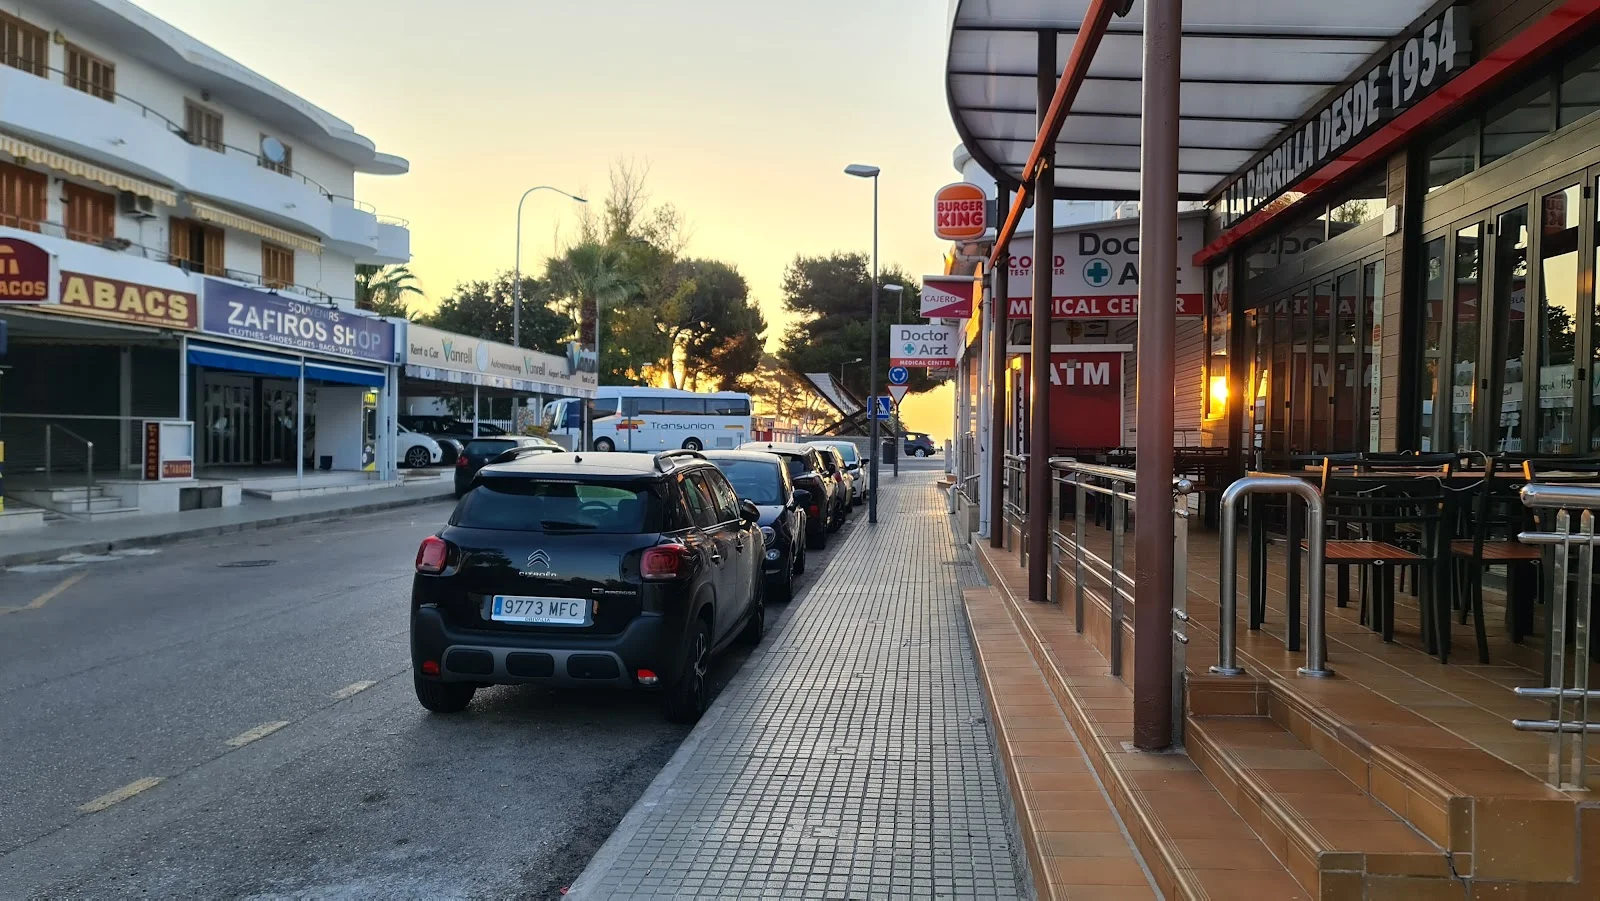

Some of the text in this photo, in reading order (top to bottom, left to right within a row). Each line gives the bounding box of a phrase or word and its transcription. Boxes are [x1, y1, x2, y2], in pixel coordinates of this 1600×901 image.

[1220, 5, 1457, 230] A LA PARRILLA DESDE 1954
[937, 201, 983, 212] BURGER
[937, 211, 983, 227] KING
[1008, 255, 1065, 268] COD
[61, 276, 189, 321] ABACS
[924, 295, 957, 303] CAJERO
[1009, 297, 1100, 315] MICAL
[288, 302, 339, 322] SOUVENIRS
[227, 301, 327, 342] ZAFIROS
[333, 324, 381, 351] SHOP
[228, 327, 264, 339] CLOTHES
[269, 334, 293, 345] SHOES
[297, 340, 315, 349] GIFTS
[319, 343, 335, 352] BAGS
[339, 346, 353, 355] TOYS
[901, 329, 949, 341] Doctor
[411, 343, 423, 355] Rent
[429, 347, 439, 358] Car
[441, 337, 473, 363] Vanrell
[919, 343, 948, 356] Arzt
[524, 356, 545, 376] Vanrell
[1050, 362, 1109, 385] ATM
[650, 422, 715, 430] Transunion
[504, 600, 579, 616] 9773 MFC
